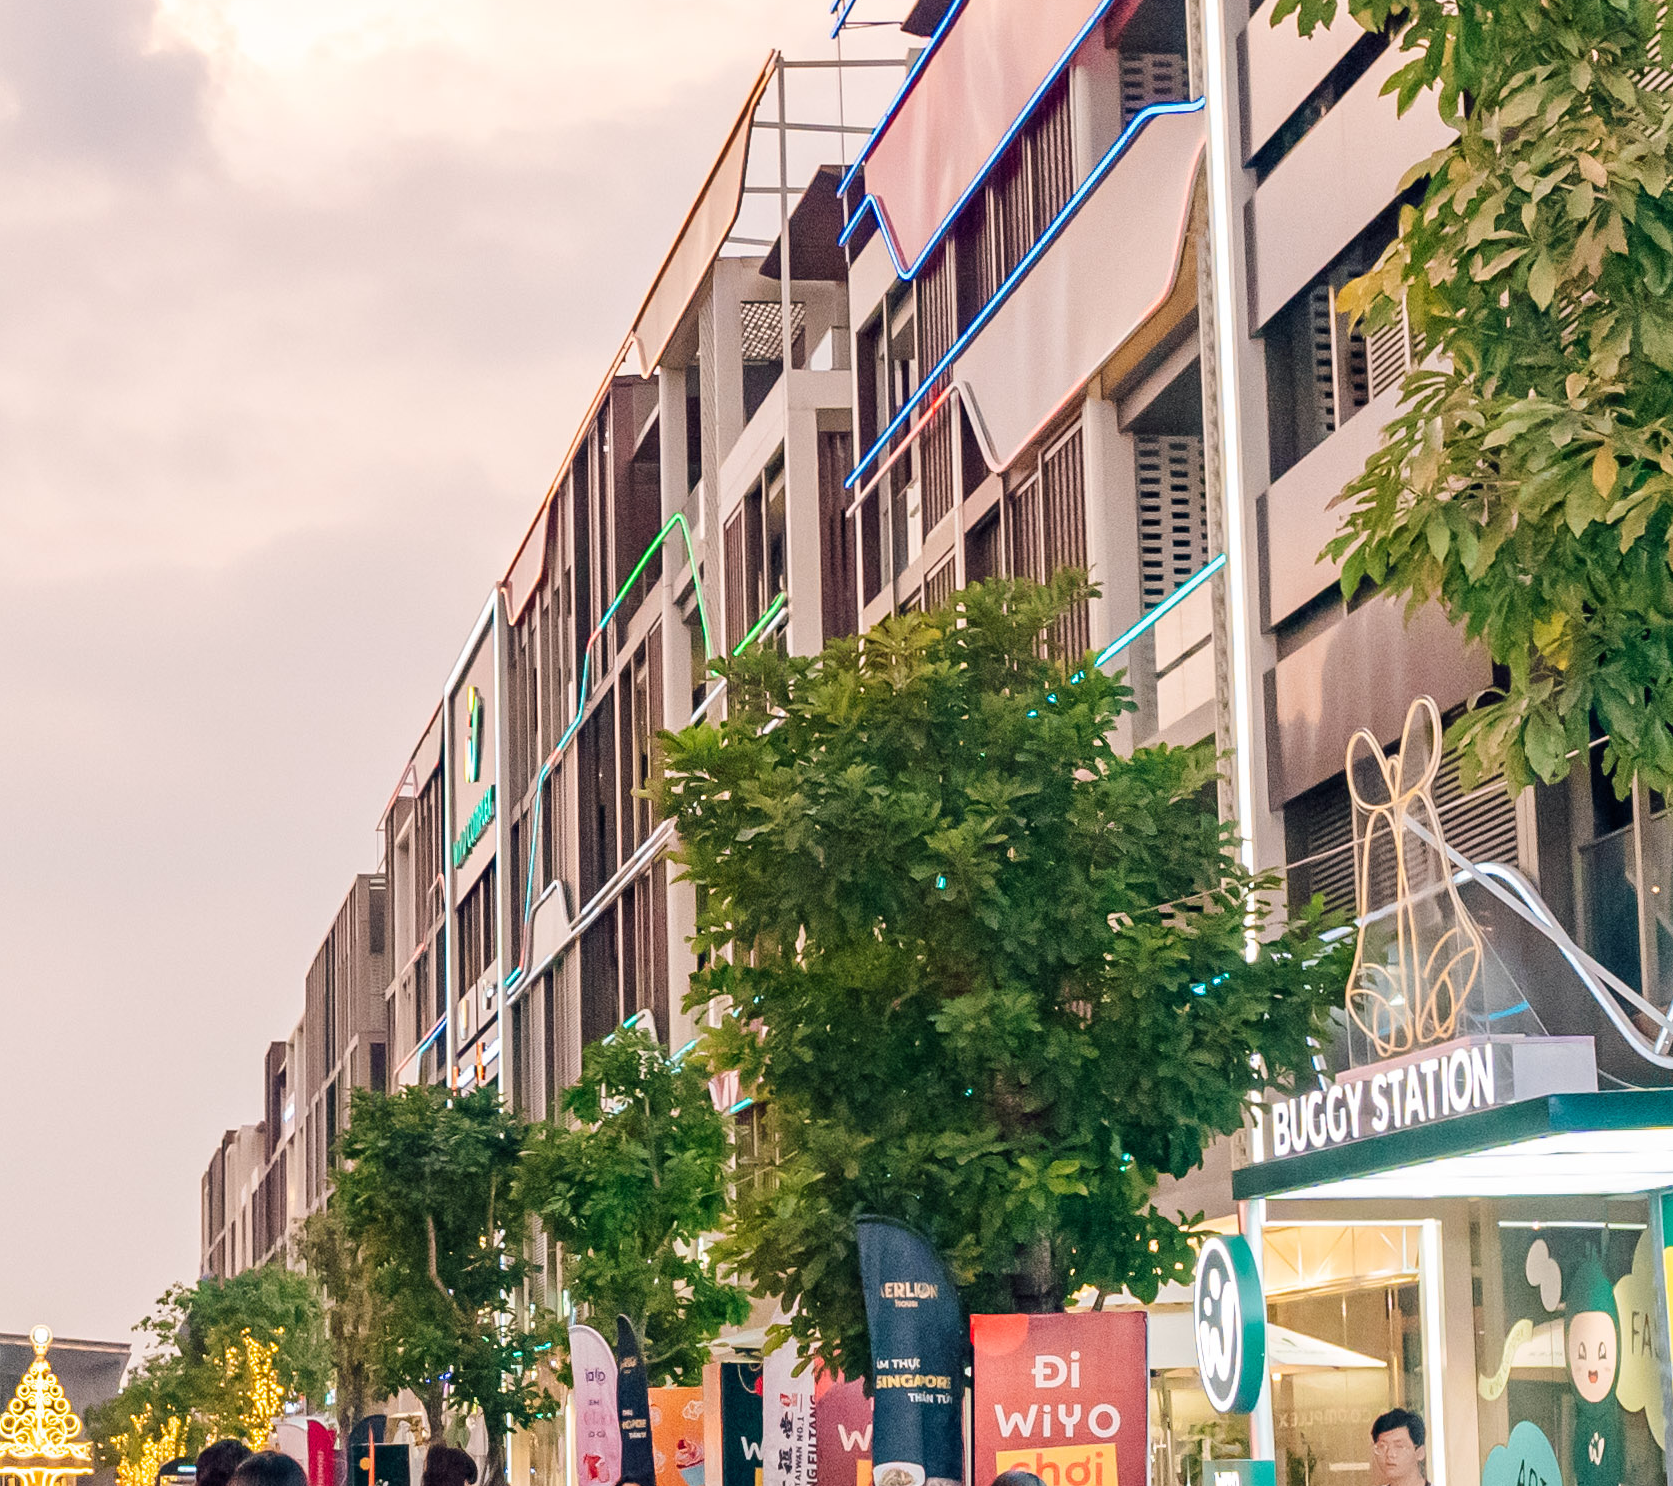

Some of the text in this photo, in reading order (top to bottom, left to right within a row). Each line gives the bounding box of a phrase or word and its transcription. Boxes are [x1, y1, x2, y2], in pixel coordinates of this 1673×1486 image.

[1271, 1042, 1495, 1158] BUGGY STATION
[1031, 1350, 1081, 1389] Đi
